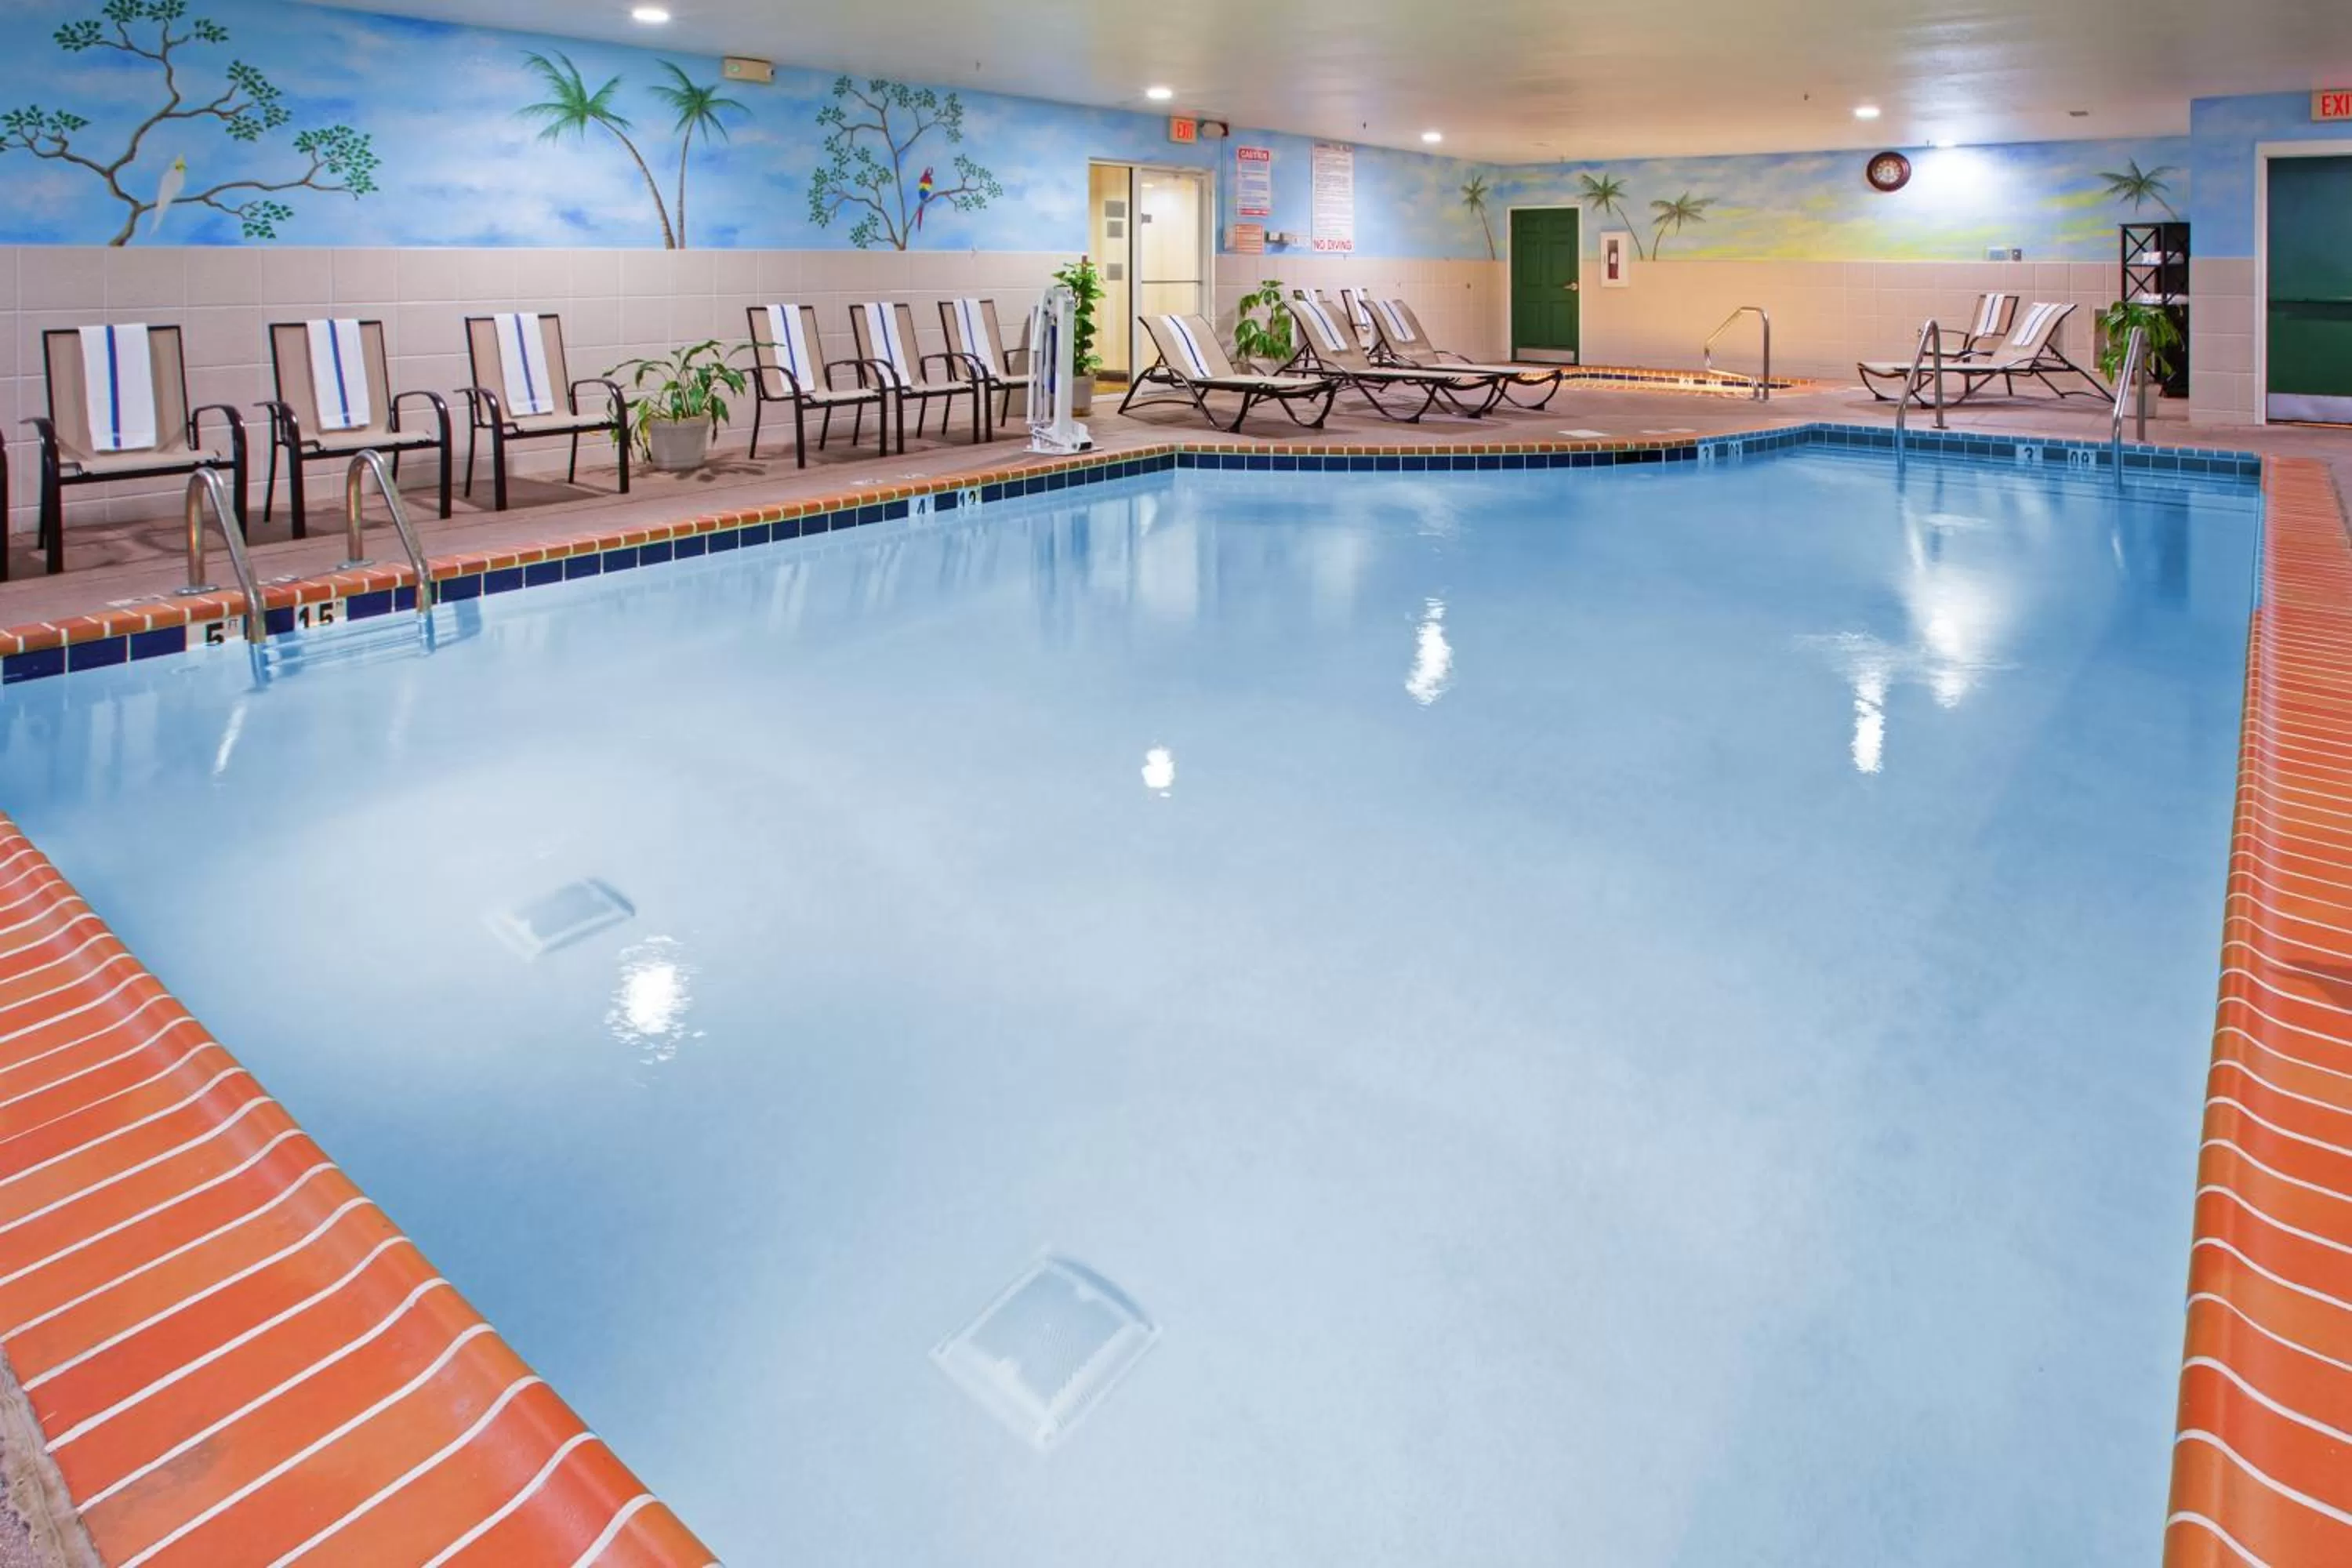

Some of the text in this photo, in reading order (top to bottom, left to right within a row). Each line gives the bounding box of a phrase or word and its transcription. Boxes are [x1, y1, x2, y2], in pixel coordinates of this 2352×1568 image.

[2321, 93, 2352, 117] EXI
[1314, 238, 1352, 251] NO DIVING
[205, 621, 224, 647] 5
